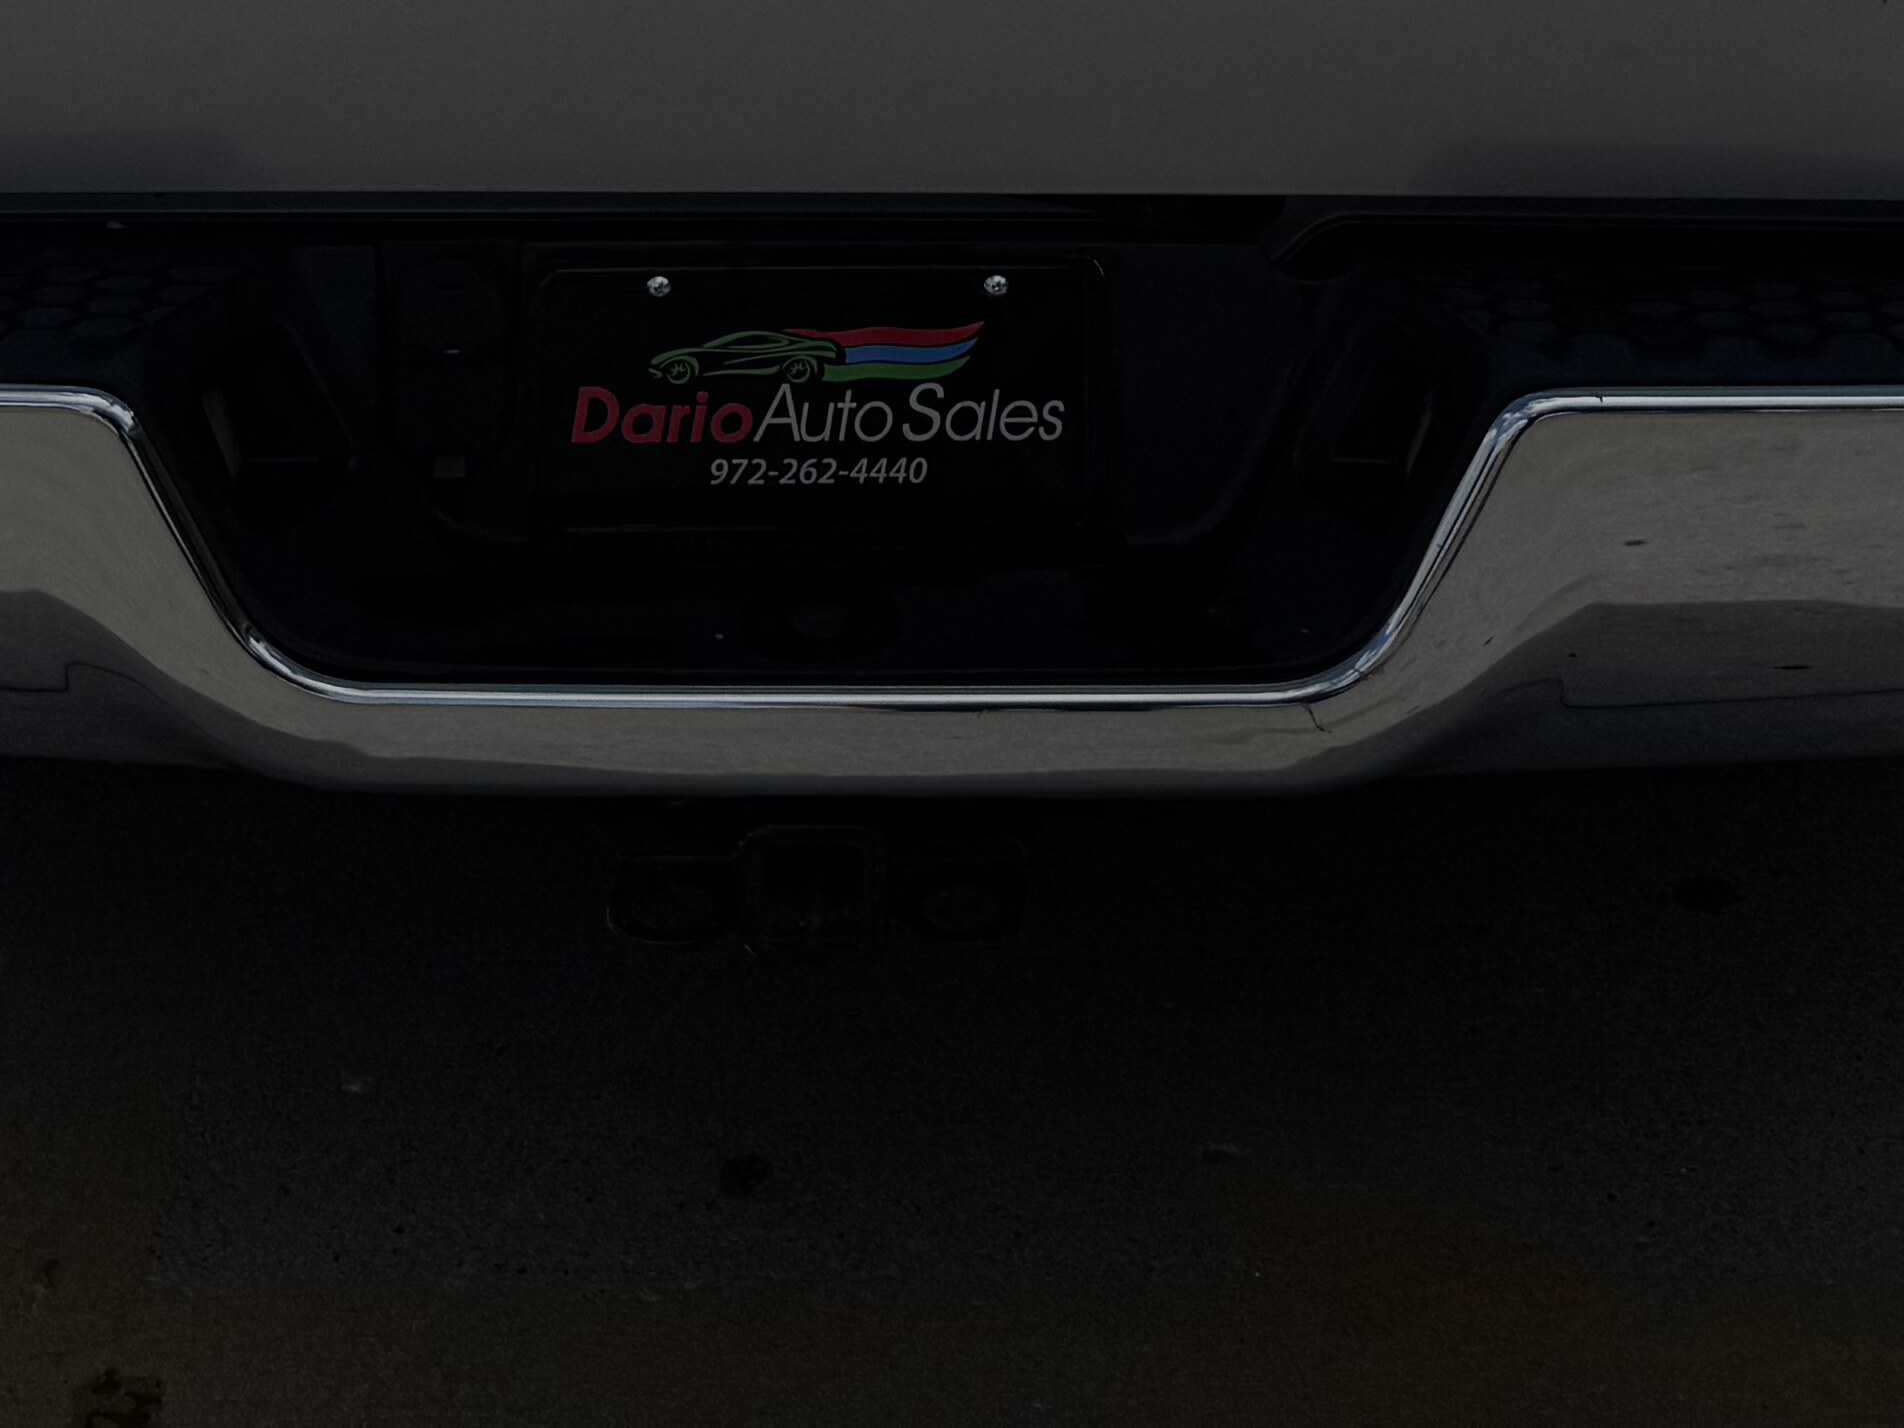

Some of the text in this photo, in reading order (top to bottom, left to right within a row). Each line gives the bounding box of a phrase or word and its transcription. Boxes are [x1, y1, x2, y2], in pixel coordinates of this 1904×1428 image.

[570, 384, 755, 446] Dario
[901, 382, 1066, 444] Sales
[709, 456, 929, 486] 972-262-4440
